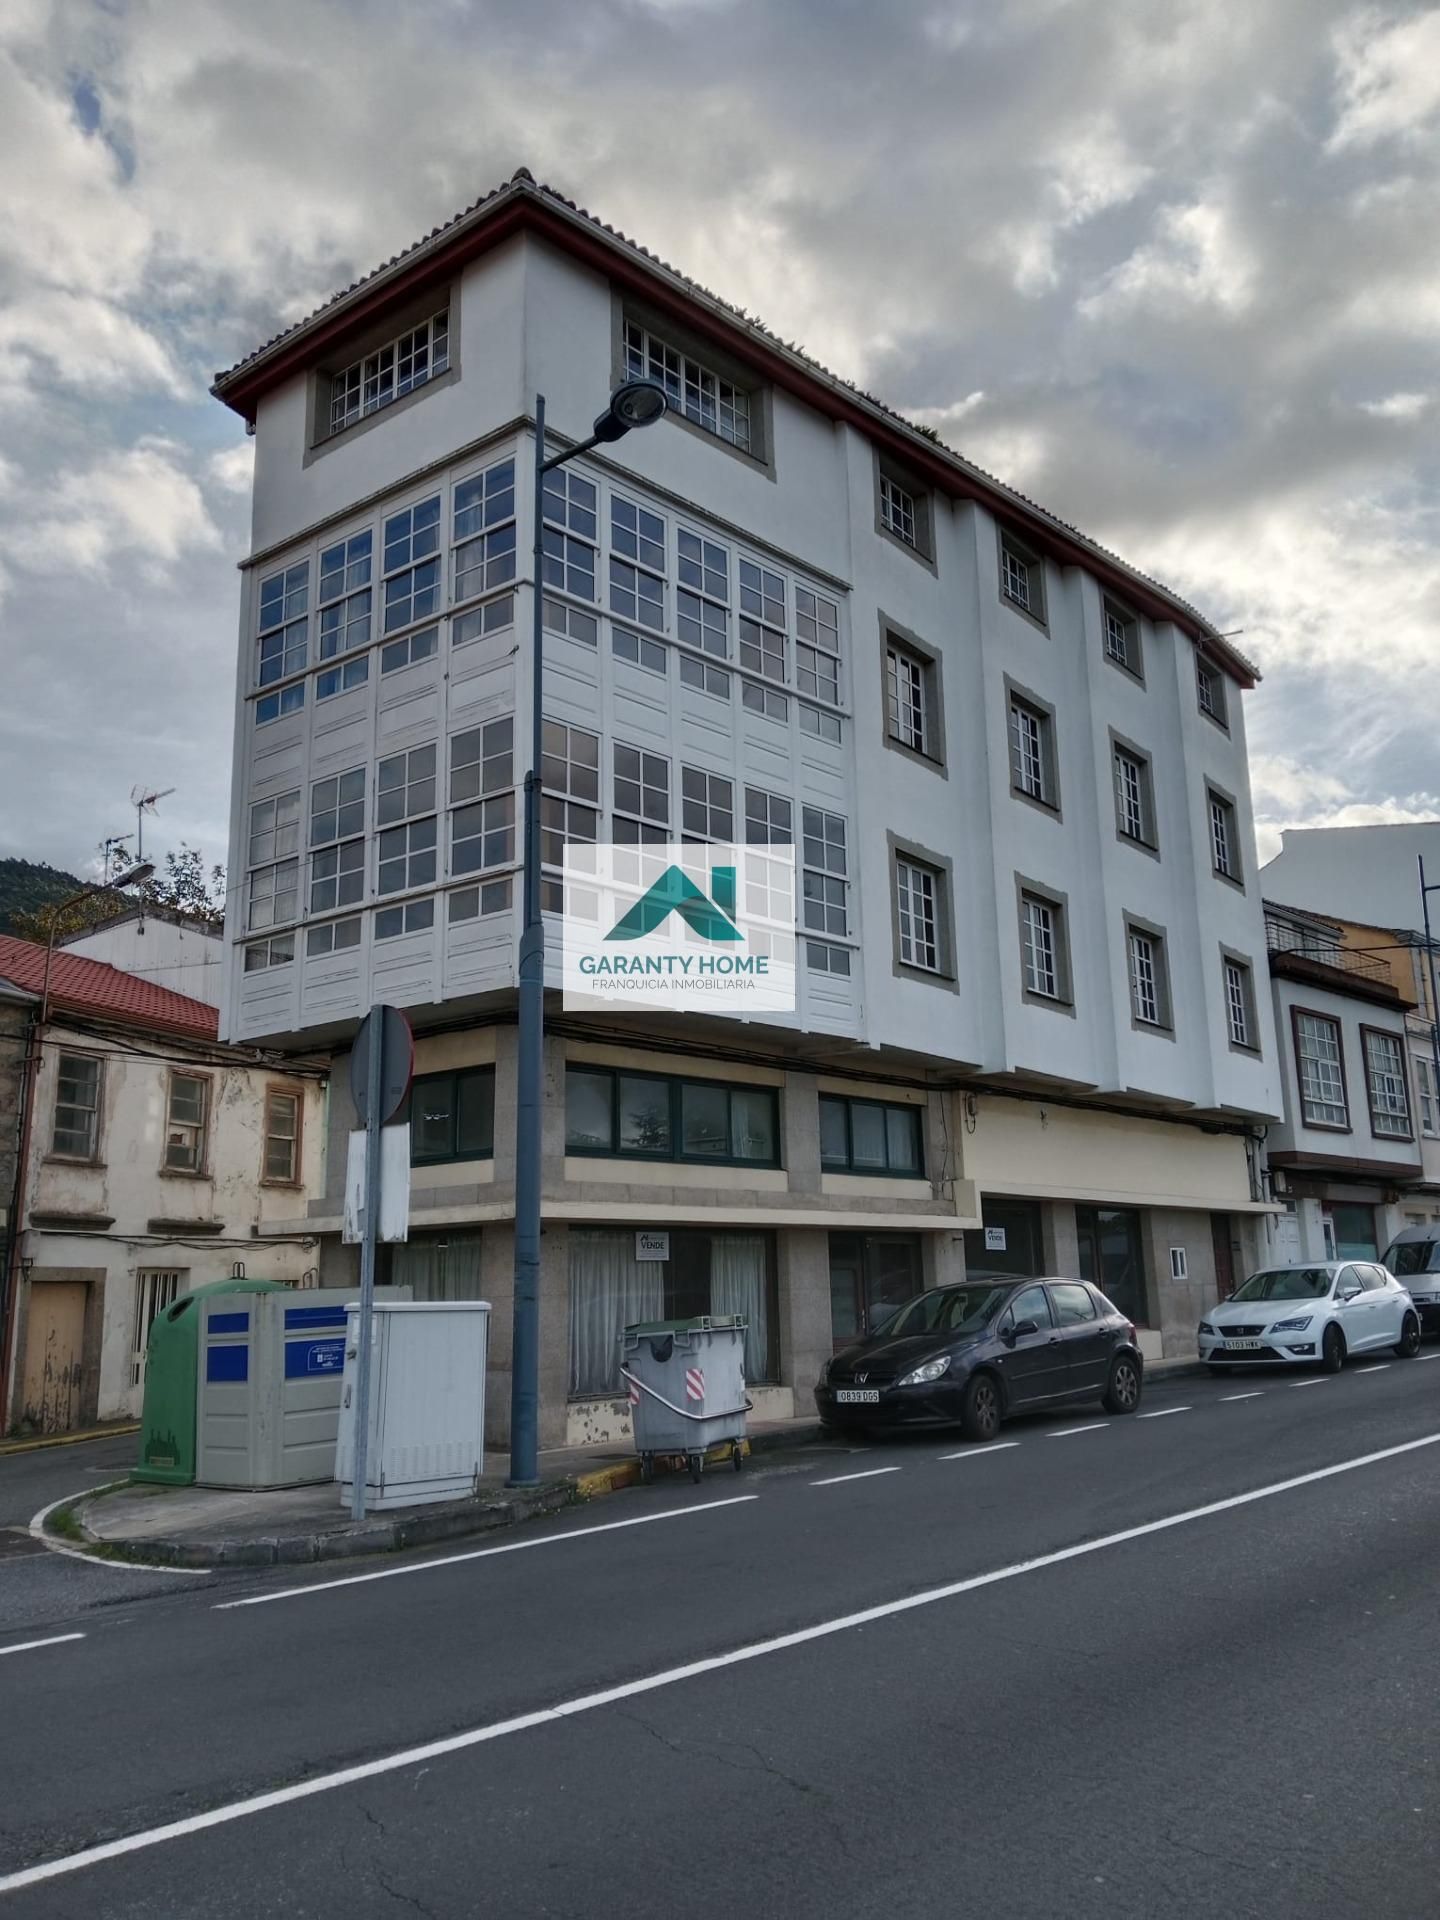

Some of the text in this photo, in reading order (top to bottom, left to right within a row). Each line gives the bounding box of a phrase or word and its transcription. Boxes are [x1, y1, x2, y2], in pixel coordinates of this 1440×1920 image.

[641, 1241, 665, 1250] VENDE
[841, 1391, 878, 1401] 0839 DGS
